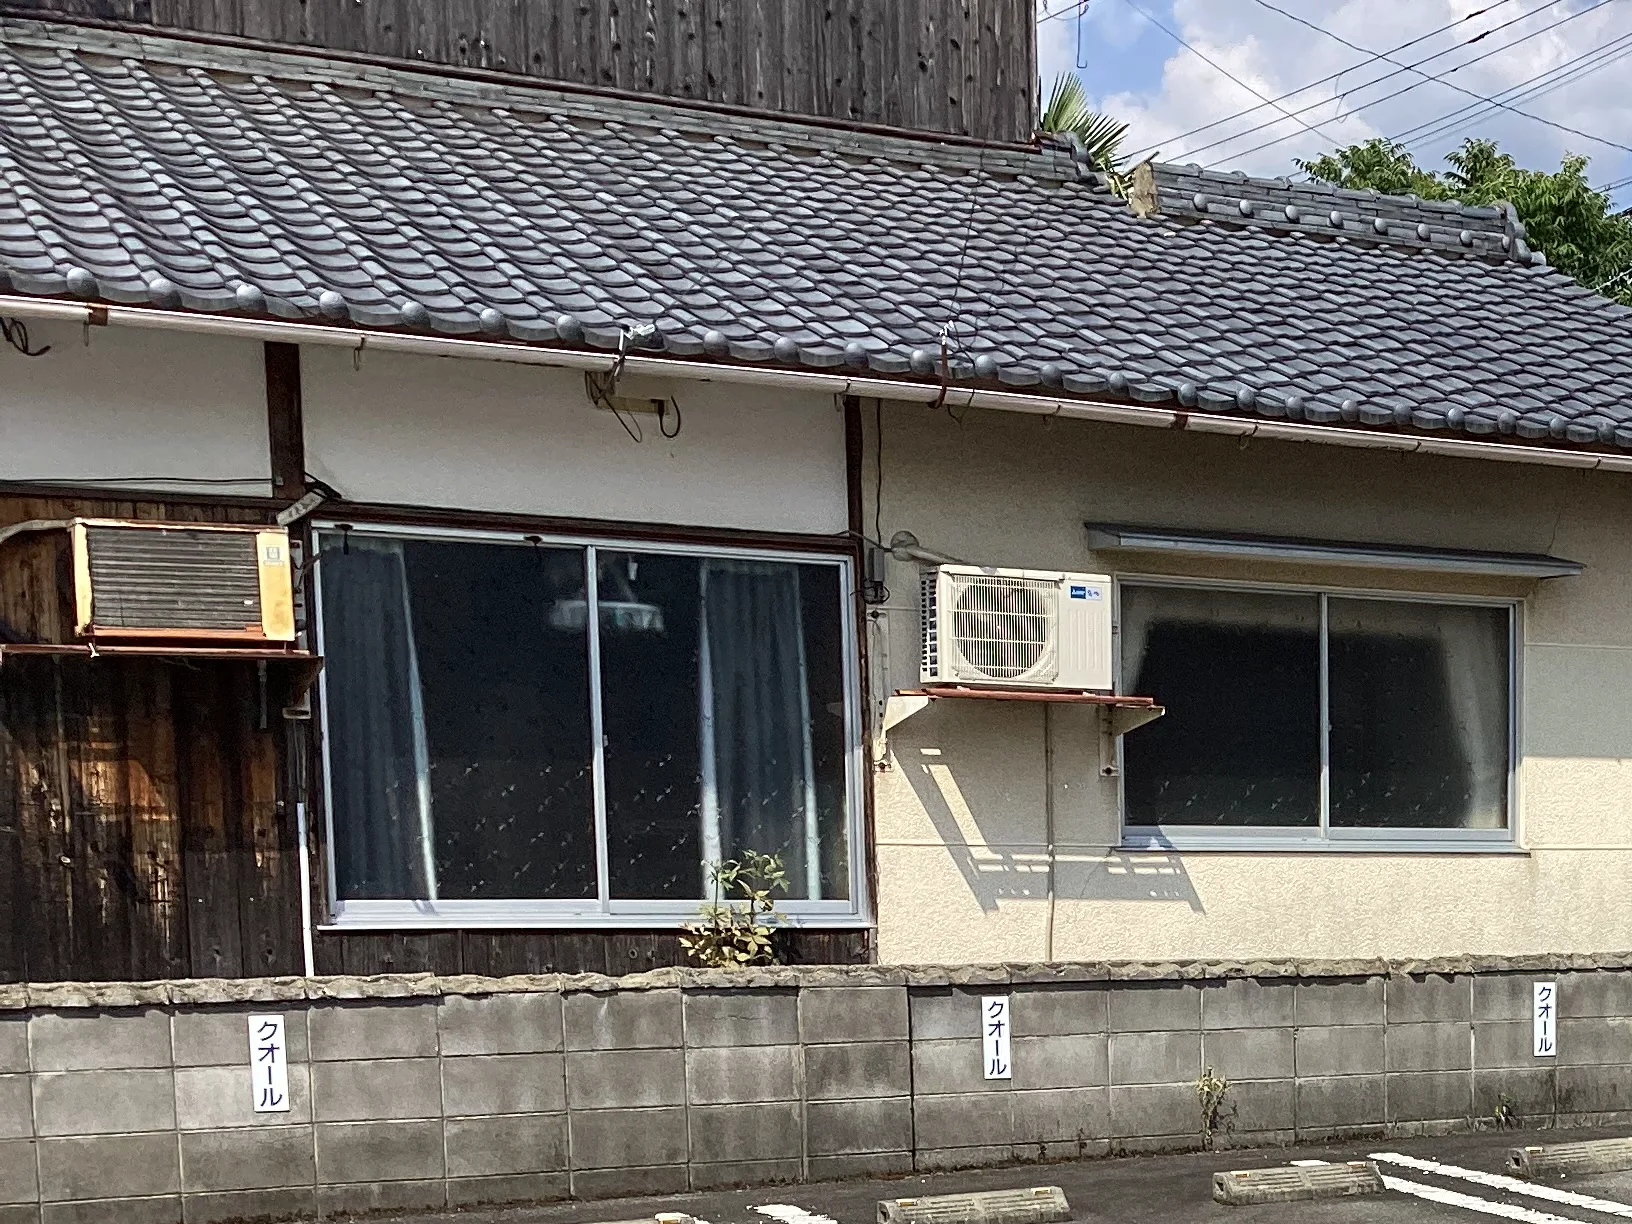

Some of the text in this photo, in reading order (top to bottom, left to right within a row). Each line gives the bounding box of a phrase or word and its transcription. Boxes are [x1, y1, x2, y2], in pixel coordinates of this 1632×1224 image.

[987, 1001, 1007, 1075] クオール
[1538, 986, 1553, 1052] クオール
[257, 1021, 283, 1107] クオール
